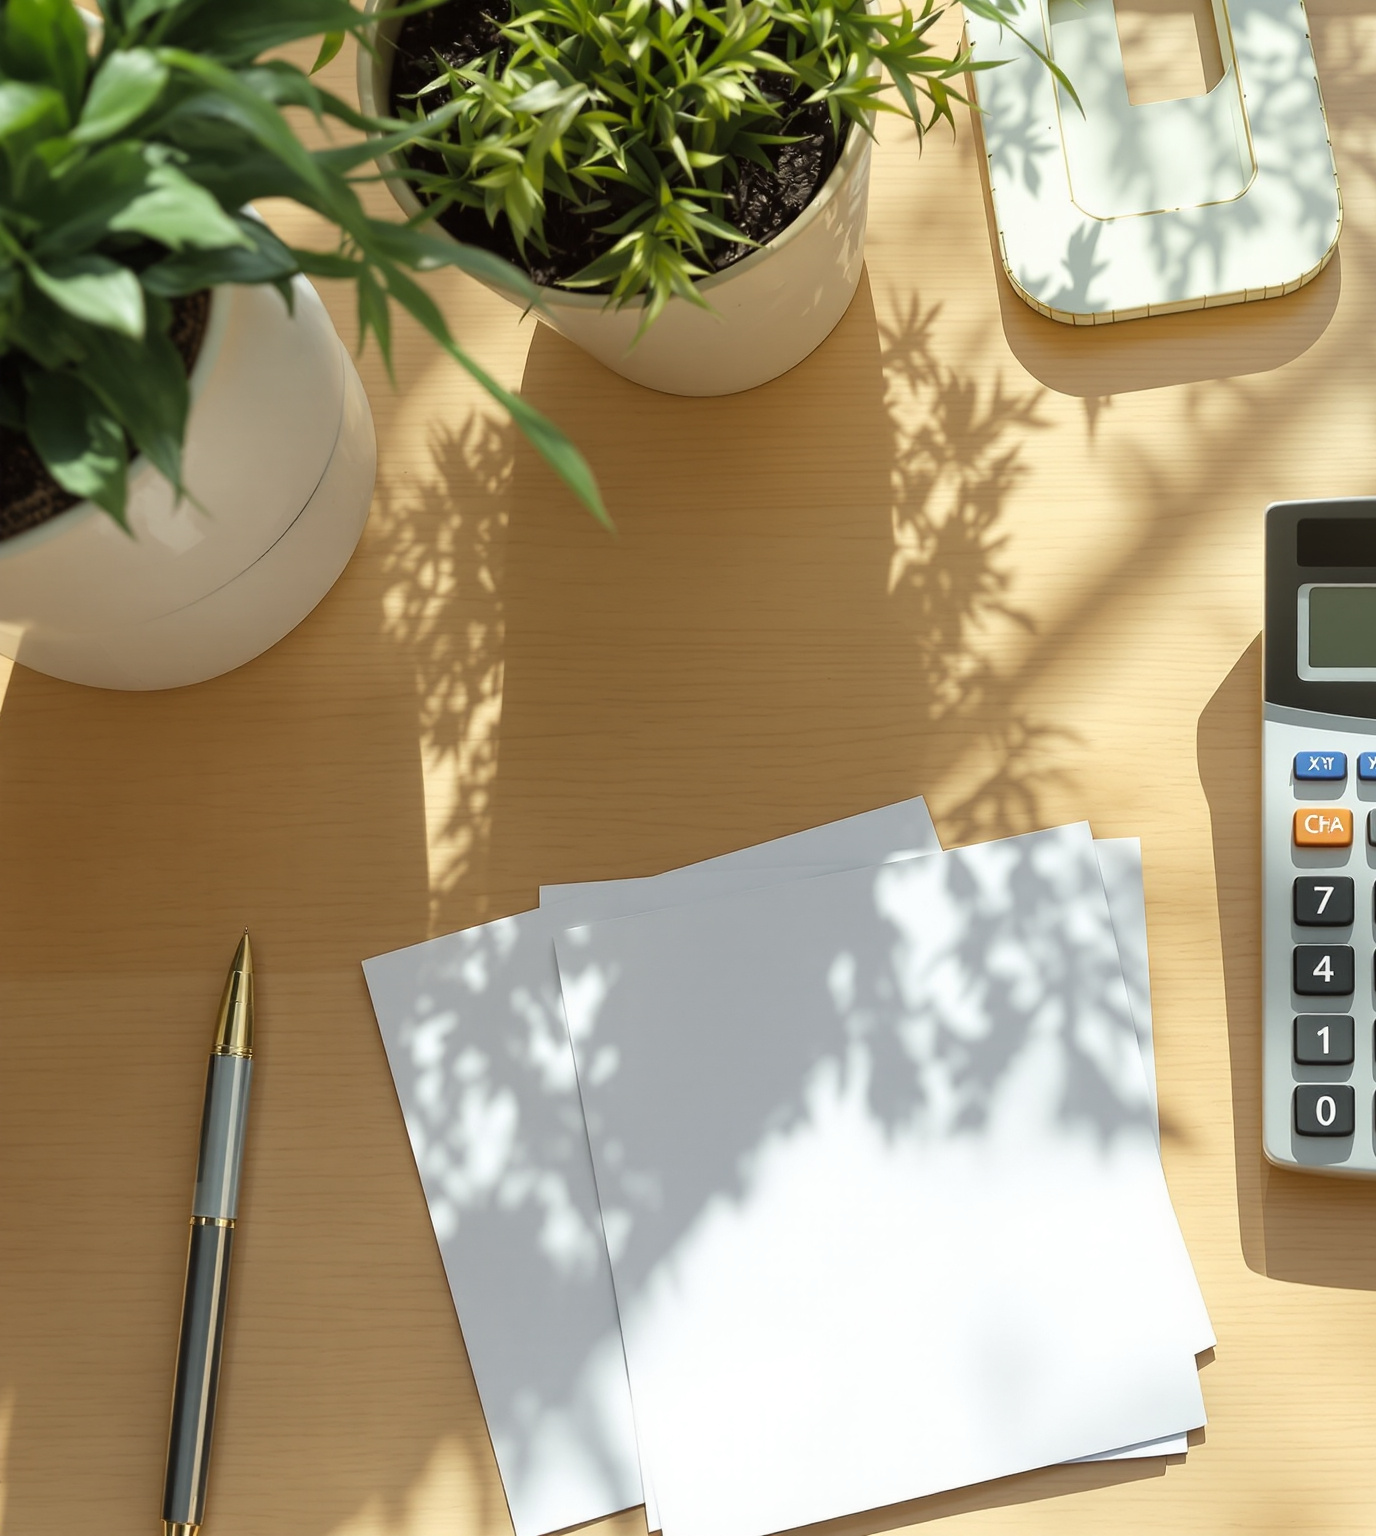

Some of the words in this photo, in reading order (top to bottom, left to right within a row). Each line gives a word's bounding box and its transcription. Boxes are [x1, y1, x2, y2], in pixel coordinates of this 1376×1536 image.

[1313, 886, 1335, 915] 7
[1312, 955, 1335, 983] 4
[1316, 1025, 1330, 1055] 1
[1315, 1095, 1336, 1126] 0
